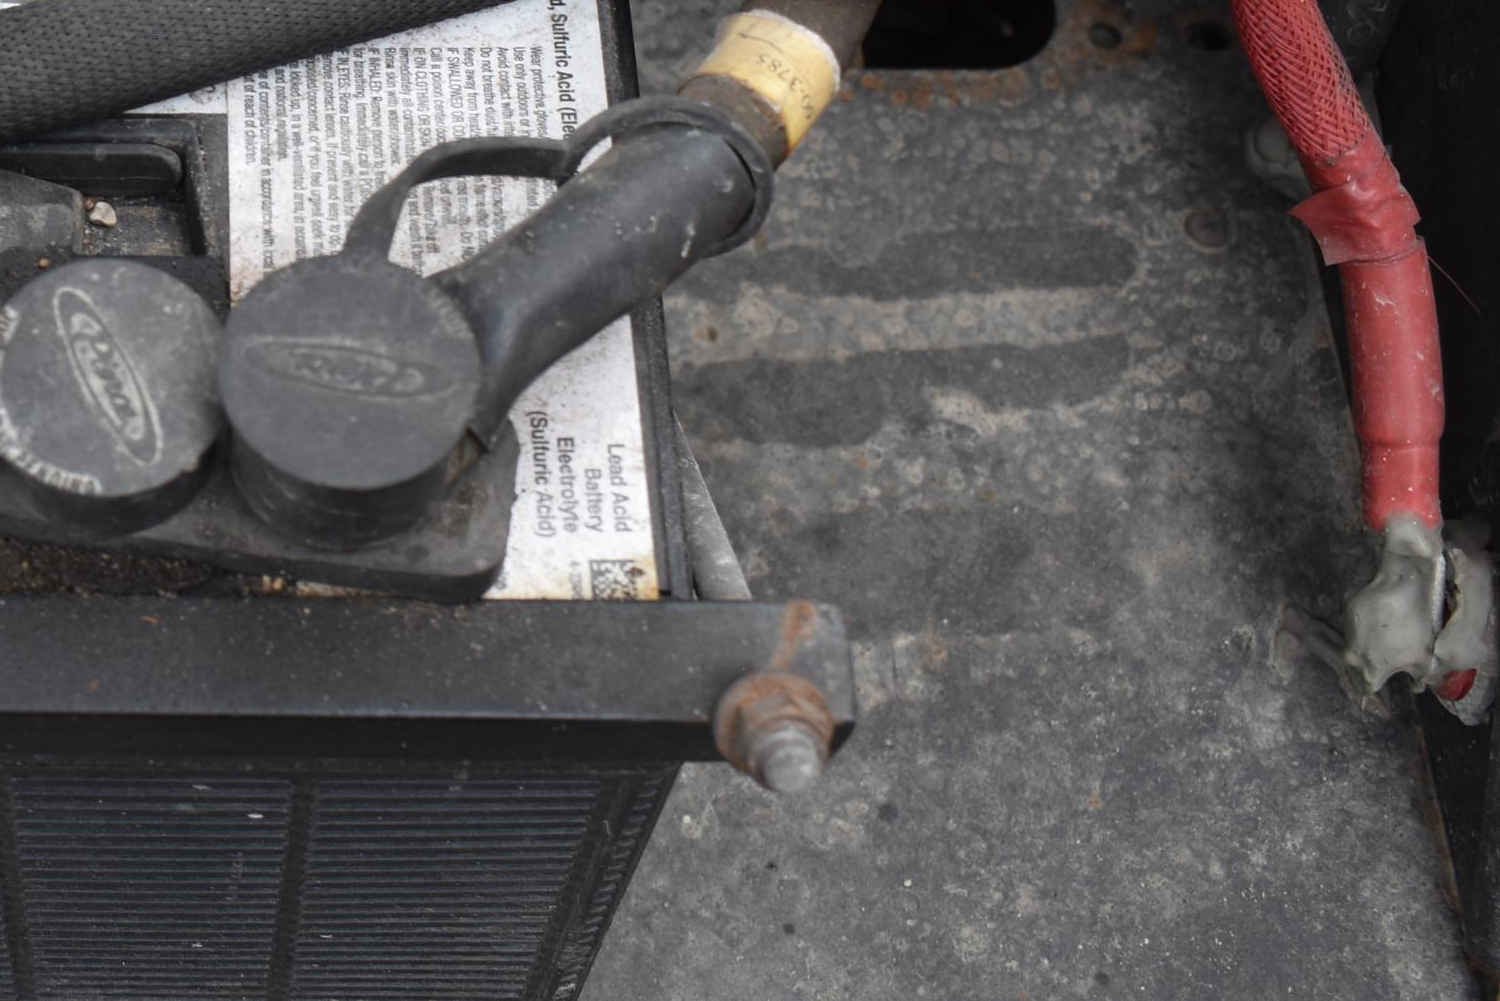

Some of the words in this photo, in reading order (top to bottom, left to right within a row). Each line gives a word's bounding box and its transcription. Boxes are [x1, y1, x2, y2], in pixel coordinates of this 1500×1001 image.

[513, 47, 525, 61] Use
[551, 14, 570, 66] Sulfuric
[462, 47, 475, 66] Keep
[497, 47, 510, 68] Avoid
[530, 46, 542, 65] Wear
[464, 69, 476, 91] away
[498, 70, 512, 99] contact
[513, 64, 527, 79] only
[557, 71, 575, 101] Acid
[467, 92, 479, 111] from
[516, 82, 529, 116] outdoors
[530, 69, 546, 107] protective
[502, 102, 514, 117] with
[526, 411, 549, 484] (Sulfuric
[607, 443, 627, 485] Lead
[556, 437, 578, 532] Electrolyte
[584, 468, 603, 531] Battery
[532, 491, 555, 537] Acid)
[612, 492, 632, 531] Acid
